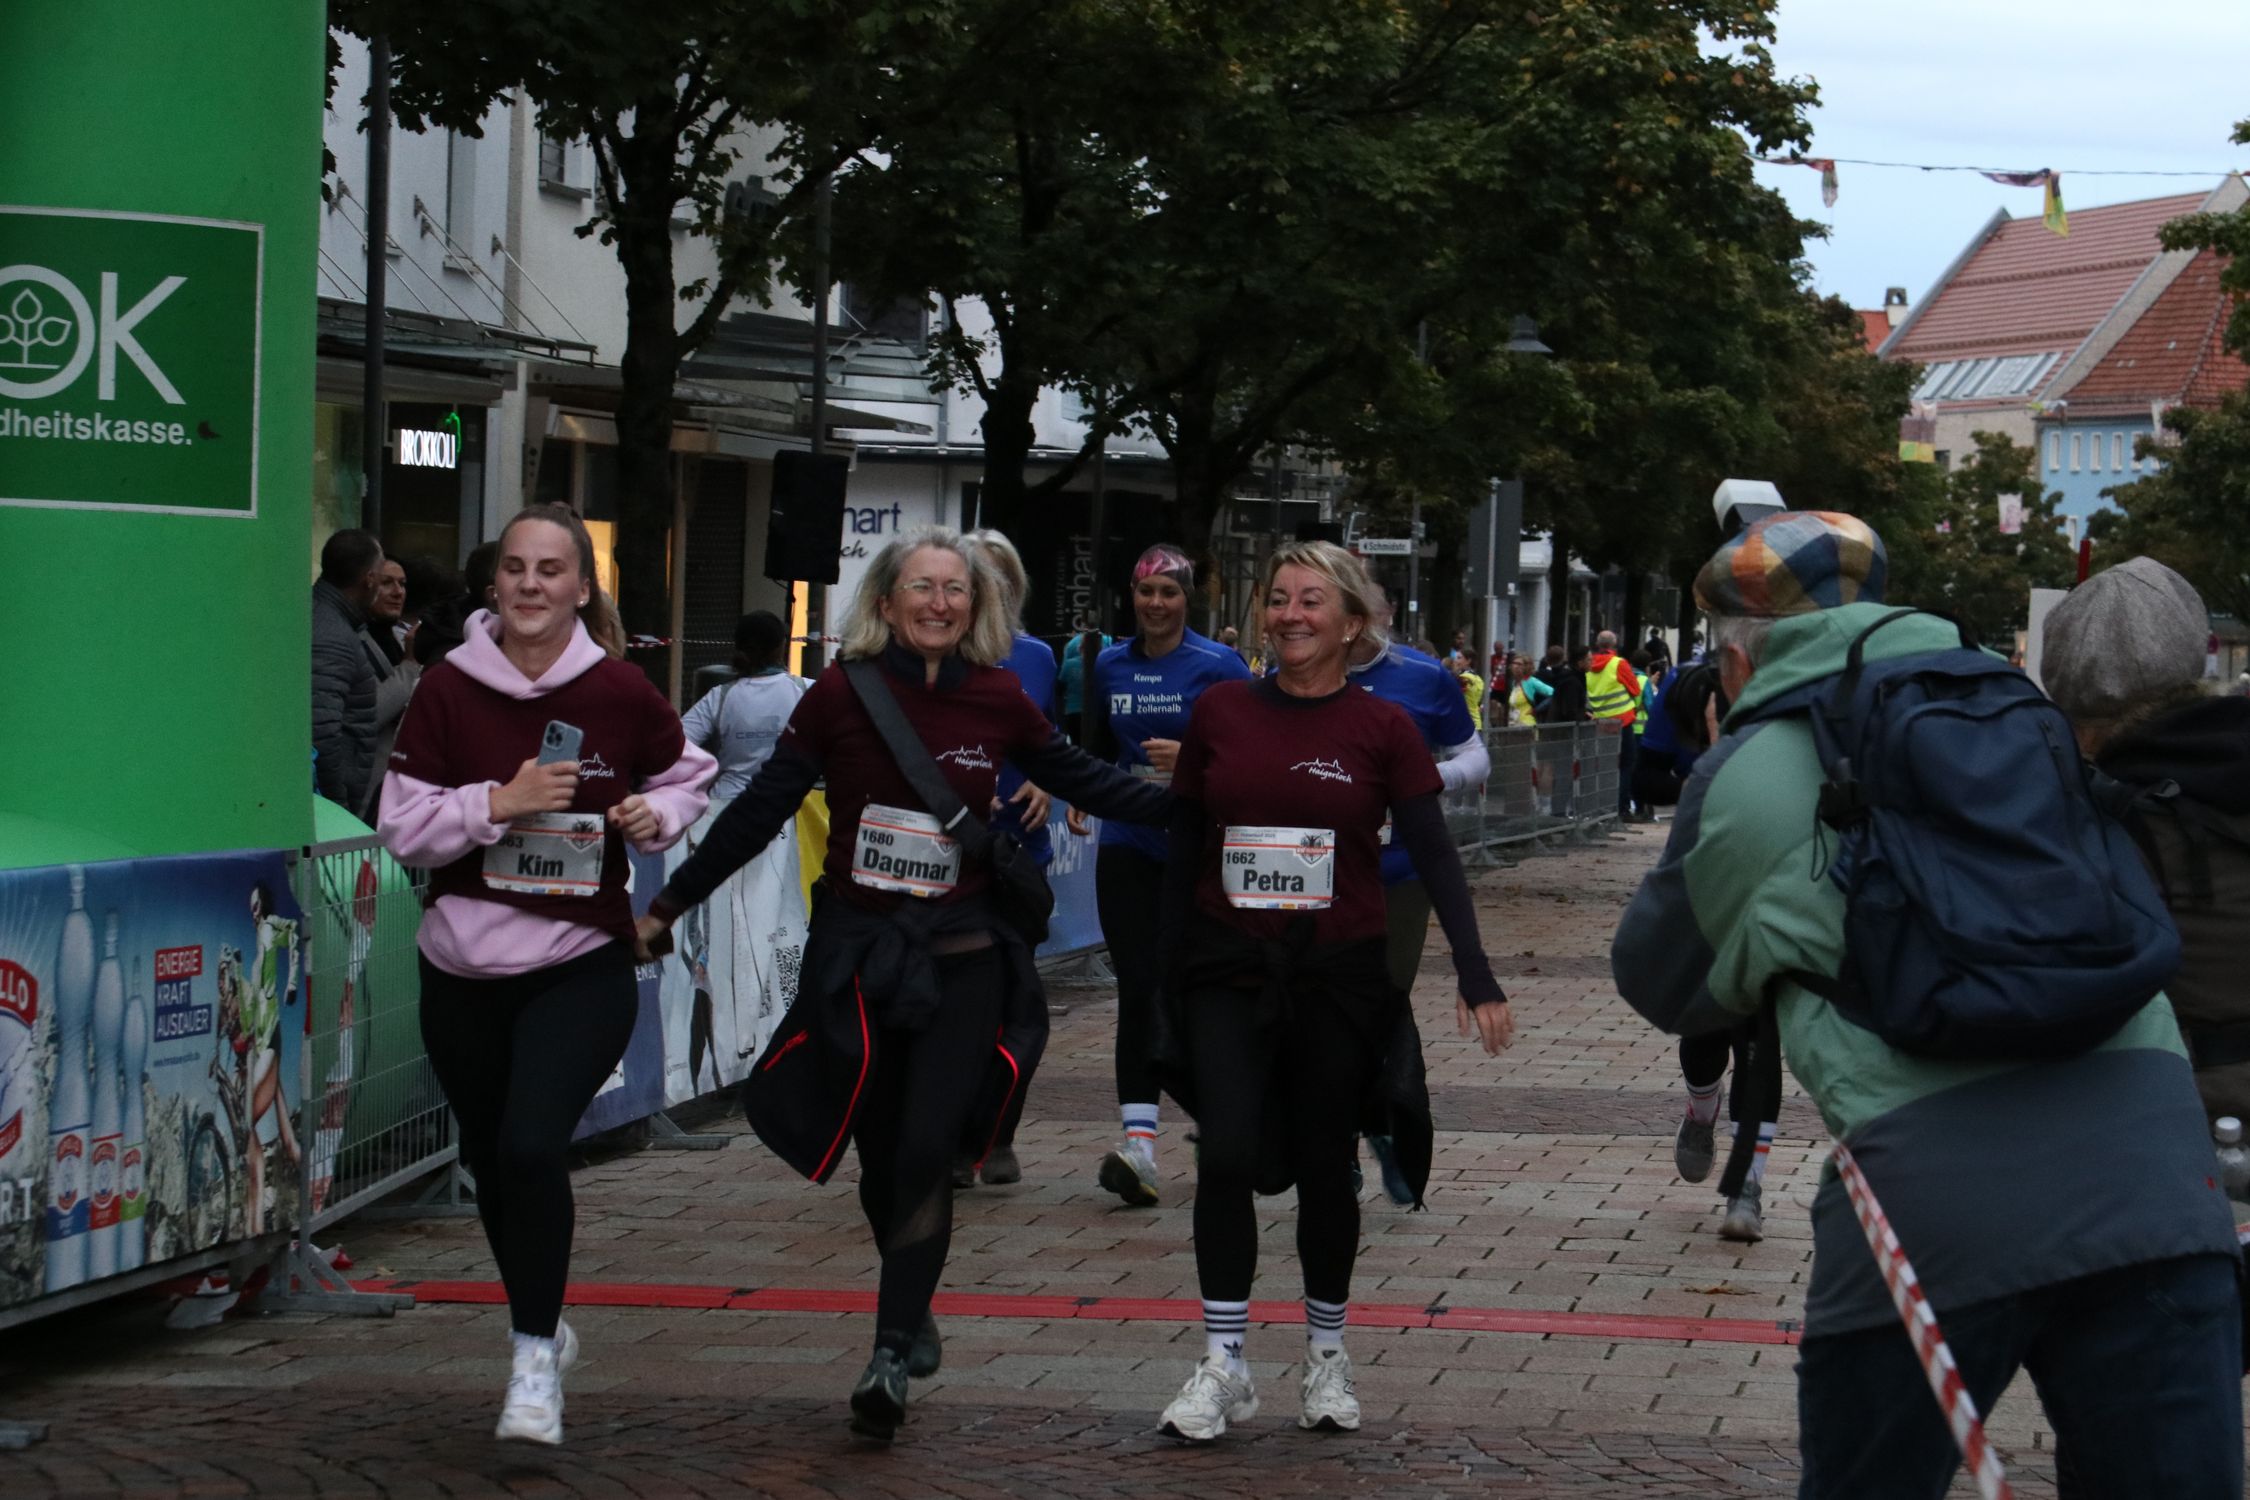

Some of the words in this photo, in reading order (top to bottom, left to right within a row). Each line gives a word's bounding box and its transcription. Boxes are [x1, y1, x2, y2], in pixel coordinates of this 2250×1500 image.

[400, 428, 456, 469] BROKKOLI
[1133, 672, 1163, 684] Kempa
[1136, 692, 1183, 703] Volksbank
[1136, 703, 1182, 714] Zollernalb
[1308, 766, 1352, 784] Haigerloch
[861, 829, 894, 846] 1680
[518, 853, 564, 877] Kim
[863, 847, 951, 882] Dagmar
[1225, 851, 1256, 864] 1662
[1243, 869, 1305, 893] Petra
[157, 949, 201, 977] ENERGIE
[157, 981, 190, 1008] KRAFT
[156, 1007, 210, 1037] AUSDAUER
